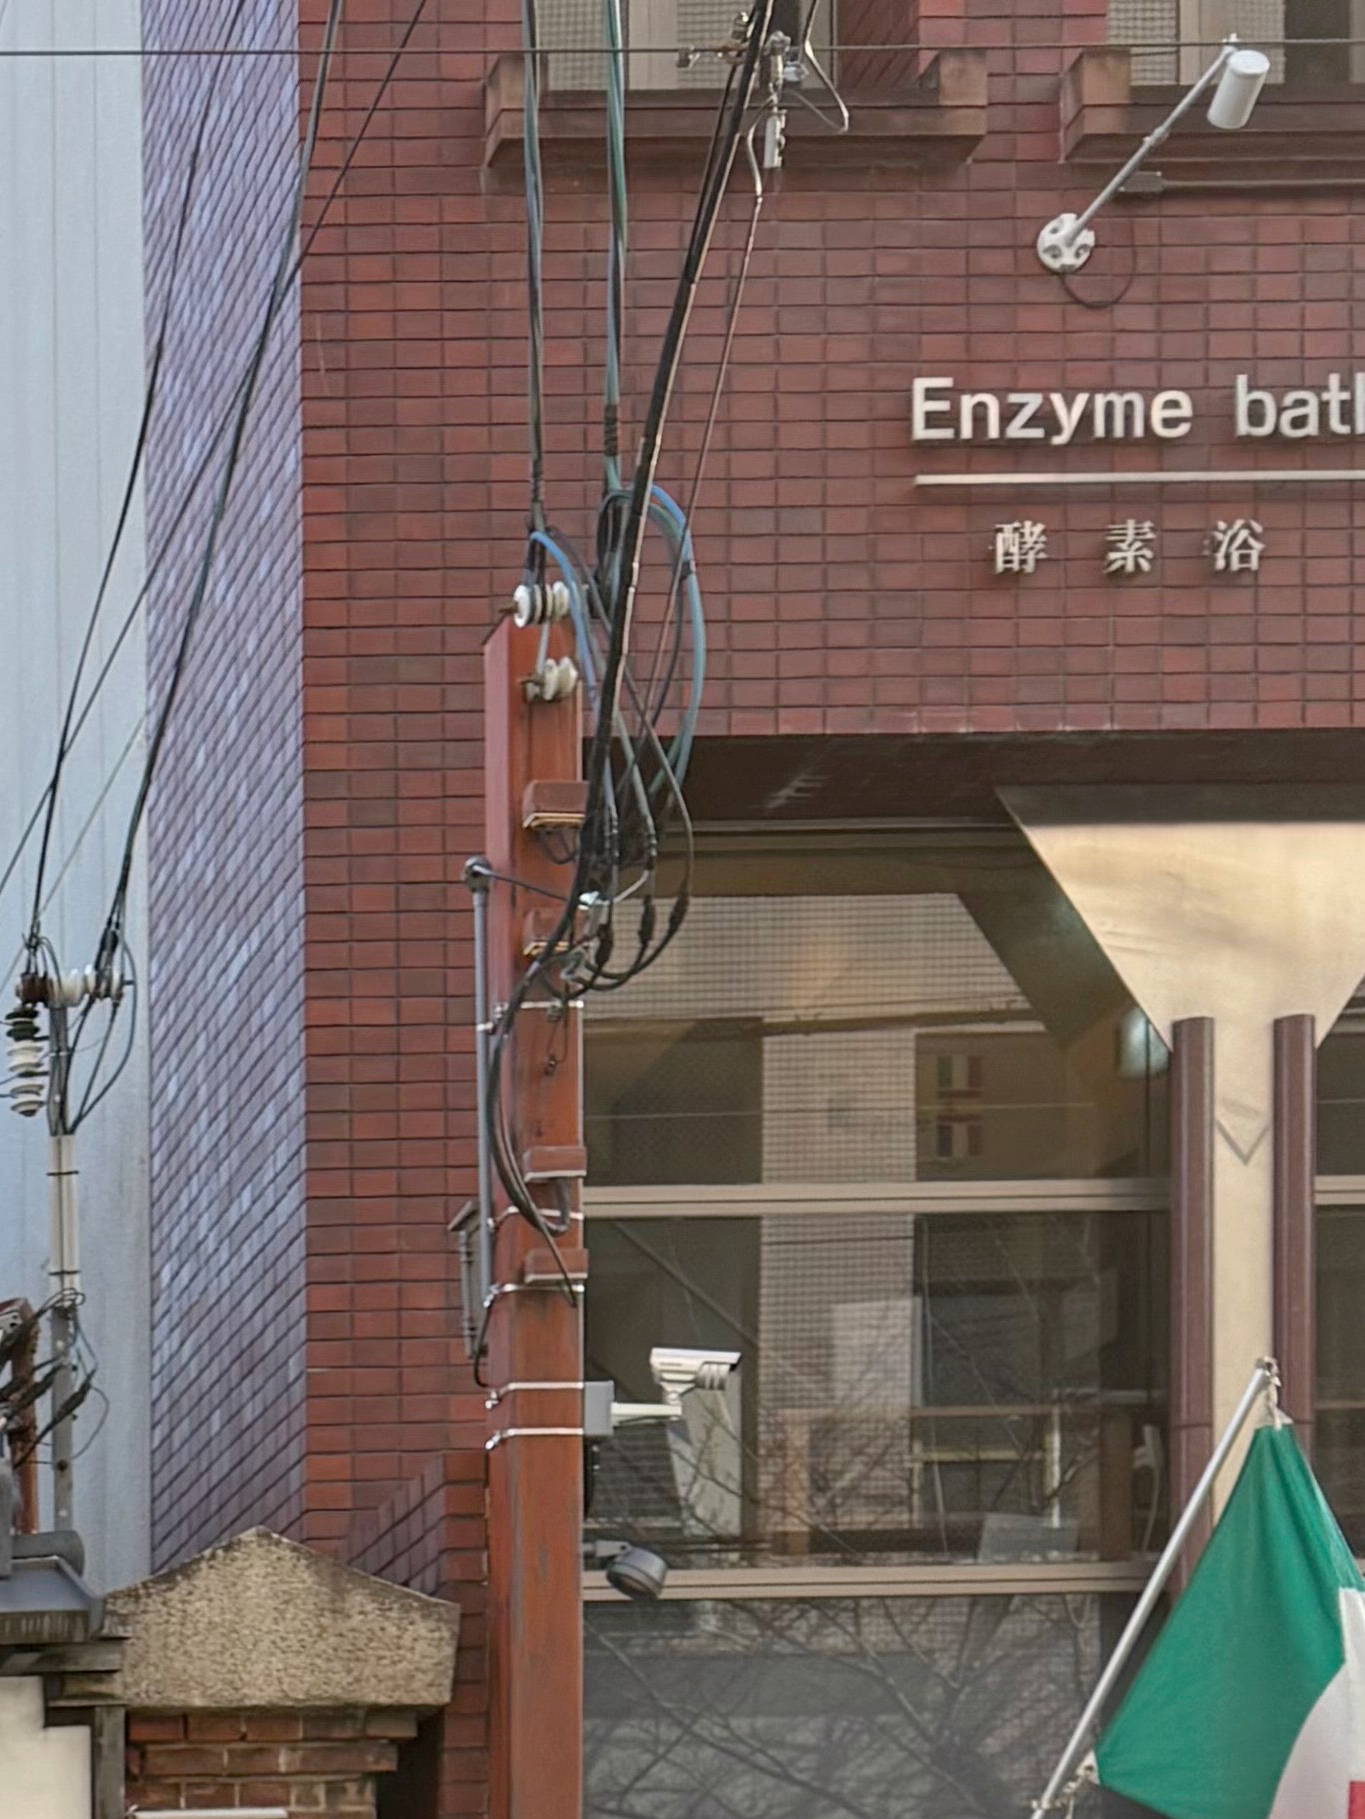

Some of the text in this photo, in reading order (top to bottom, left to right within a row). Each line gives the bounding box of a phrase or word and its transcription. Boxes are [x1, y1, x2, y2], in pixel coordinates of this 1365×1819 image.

[911, 376, 1193, 445] Enzyme
[993, 518, 1266, 574] 酵素浴
